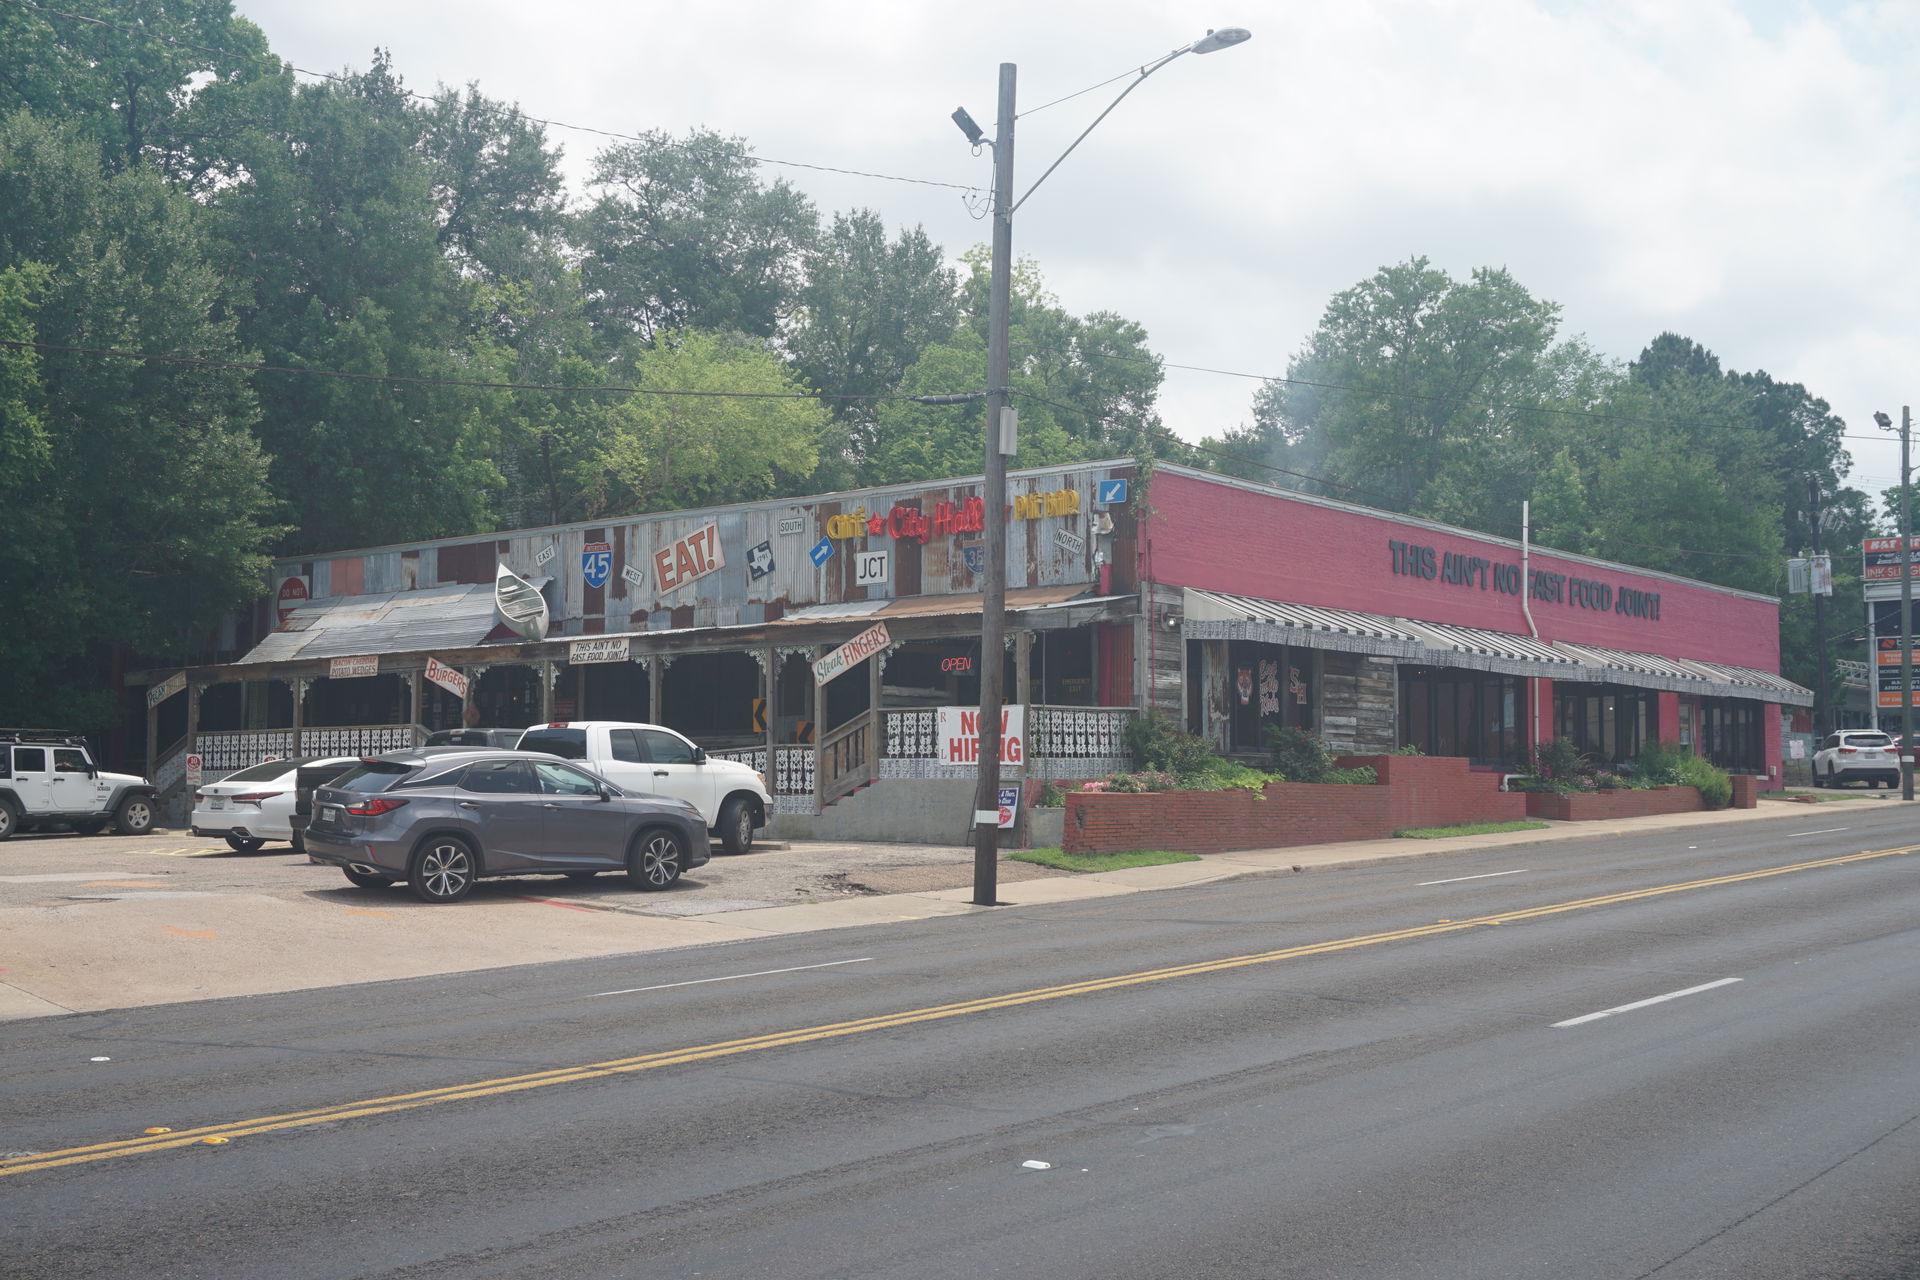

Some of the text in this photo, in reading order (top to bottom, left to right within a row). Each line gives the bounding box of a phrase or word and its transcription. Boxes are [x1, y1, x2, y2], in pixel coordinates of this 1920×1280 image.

[781, 520, 801, 531] SOUTH
[888, 496, 985, 544] City Hall
[1056, 531, 1082, 552] NORTH
[537, 549, 553, 565] EAST
[656, 526, 715, 592] EAT!
[859, 556, 885, 579] JCT
[584, 557, 611, 579] 45
[625, 567, 640, 582] WEST
[1389, 539, 1437, 580] THIS
[1441, 552, 1490, 590] AIN'T
[1494, 562, 1521, 595] NO
[1570, 577, 1613, 611] FOOD
[1616, 586, 1661, 620] JOINT!
[571, 648, 627, 662] FAST FOOD JOINT!
[576, 642, 592, 653] THIS
[611, 640, 622, 649] NO
[817, 625, 887, 682] Steak FINGERS
[332, 665, 376, 678] POTATO WEDGES
[941, 656, 971, 671] OPEN
[427, 663, 467, 696] BURGERS
